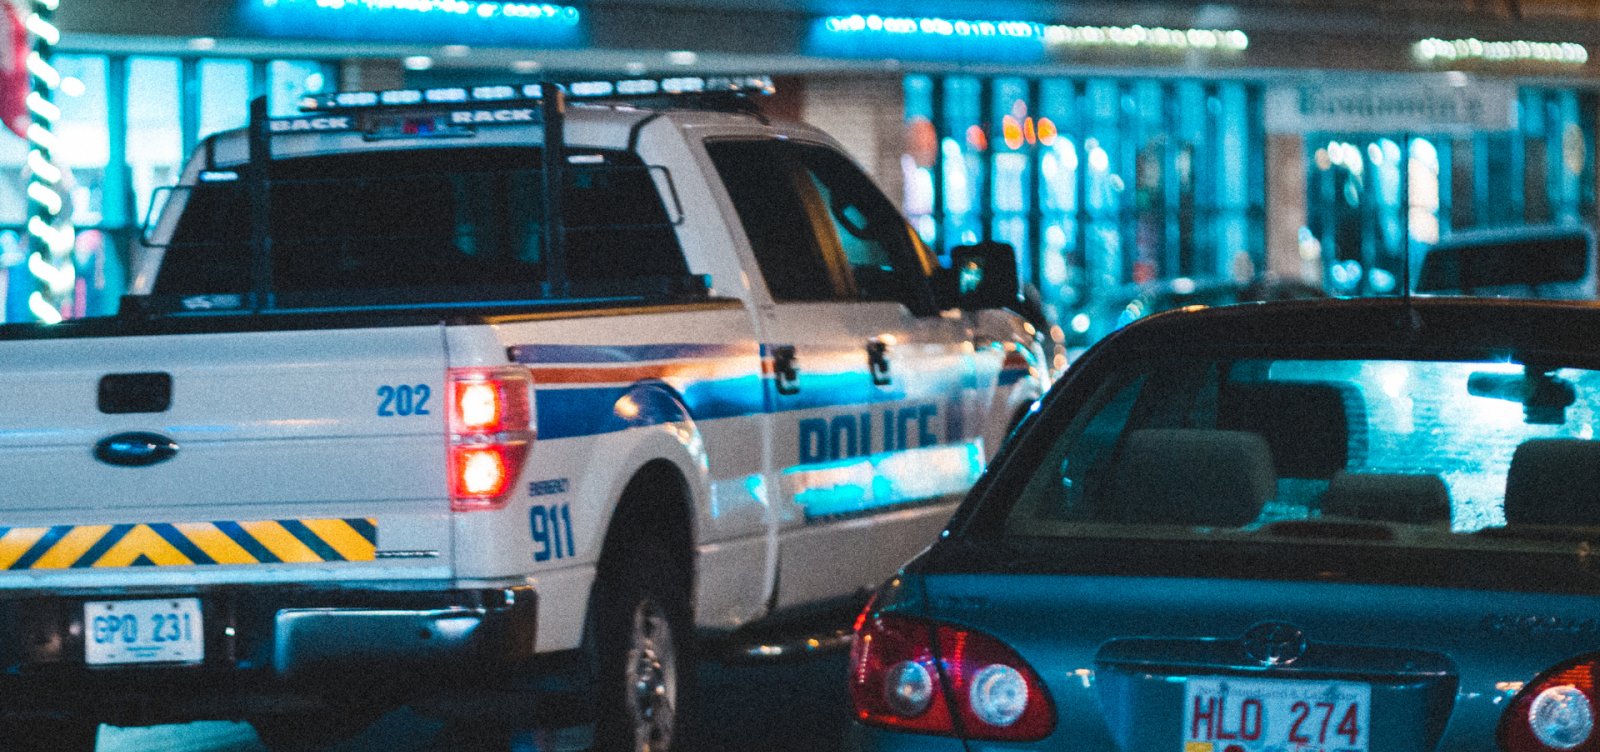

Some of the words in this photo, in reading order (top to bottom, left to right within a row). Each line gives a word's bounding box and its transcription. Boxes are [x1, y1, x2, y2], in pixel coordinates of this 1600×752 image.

[269, 117, 349, 132] BACK
[451, 108, 534, 124] RACK
[377, 384, 431, 417] 202
[799, 404, 938, 466] POLICE
[528, 503, 575, 562] 911
[150, 612, 192, 643] 231
[1191, 695, 1263, 741] HLO
[1288, 700, 1360, 745] 274
